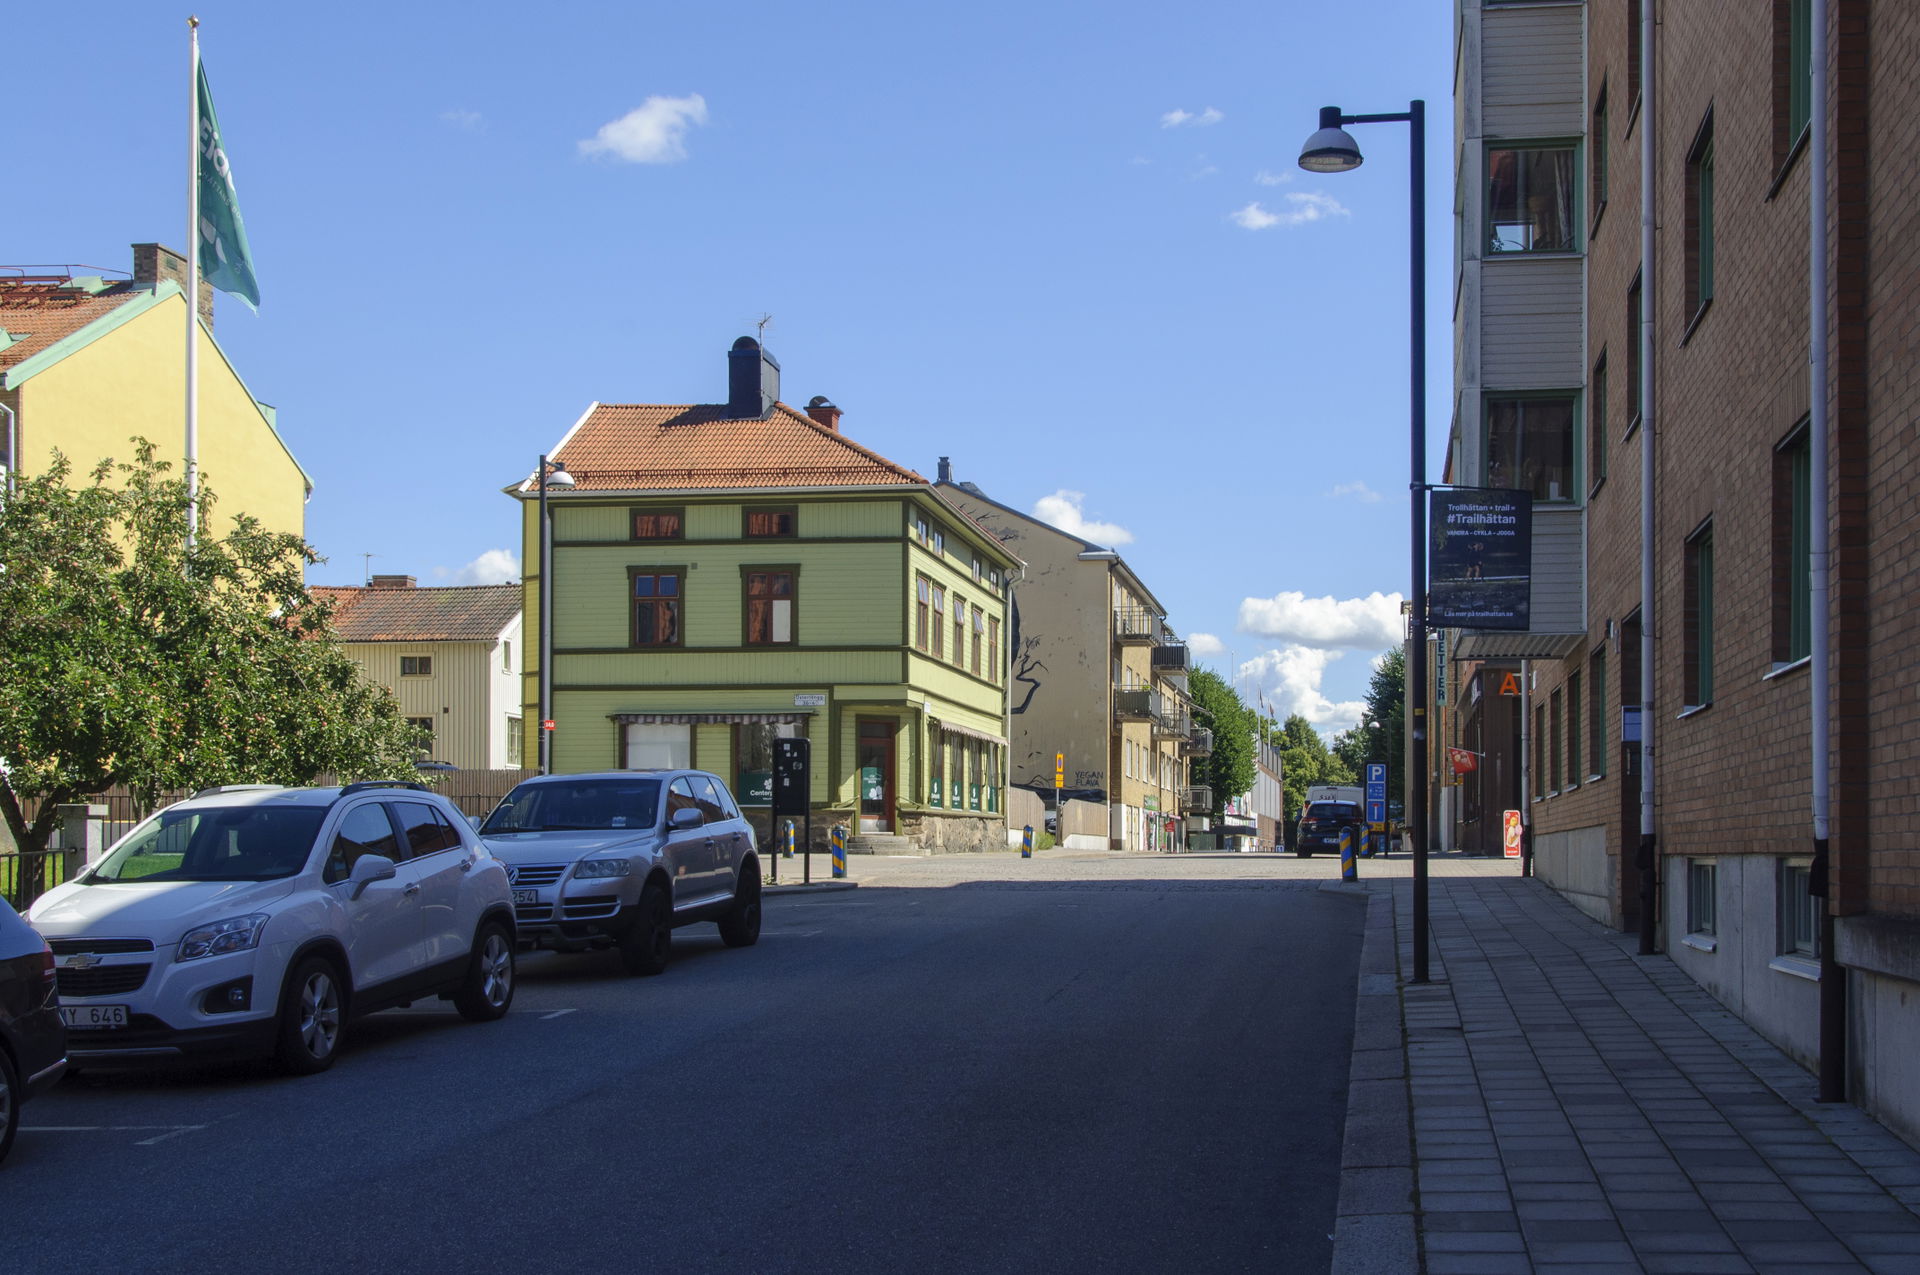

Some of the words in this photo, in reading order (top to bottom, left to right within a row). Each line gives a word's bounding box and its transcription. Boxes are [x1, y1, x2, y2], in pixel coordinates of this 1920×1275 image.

[1495, 504, 1510, 512] trail
[1447, 513, 1516, 524] #Trailhättan
[90, 1007, 122, 1024] 646
